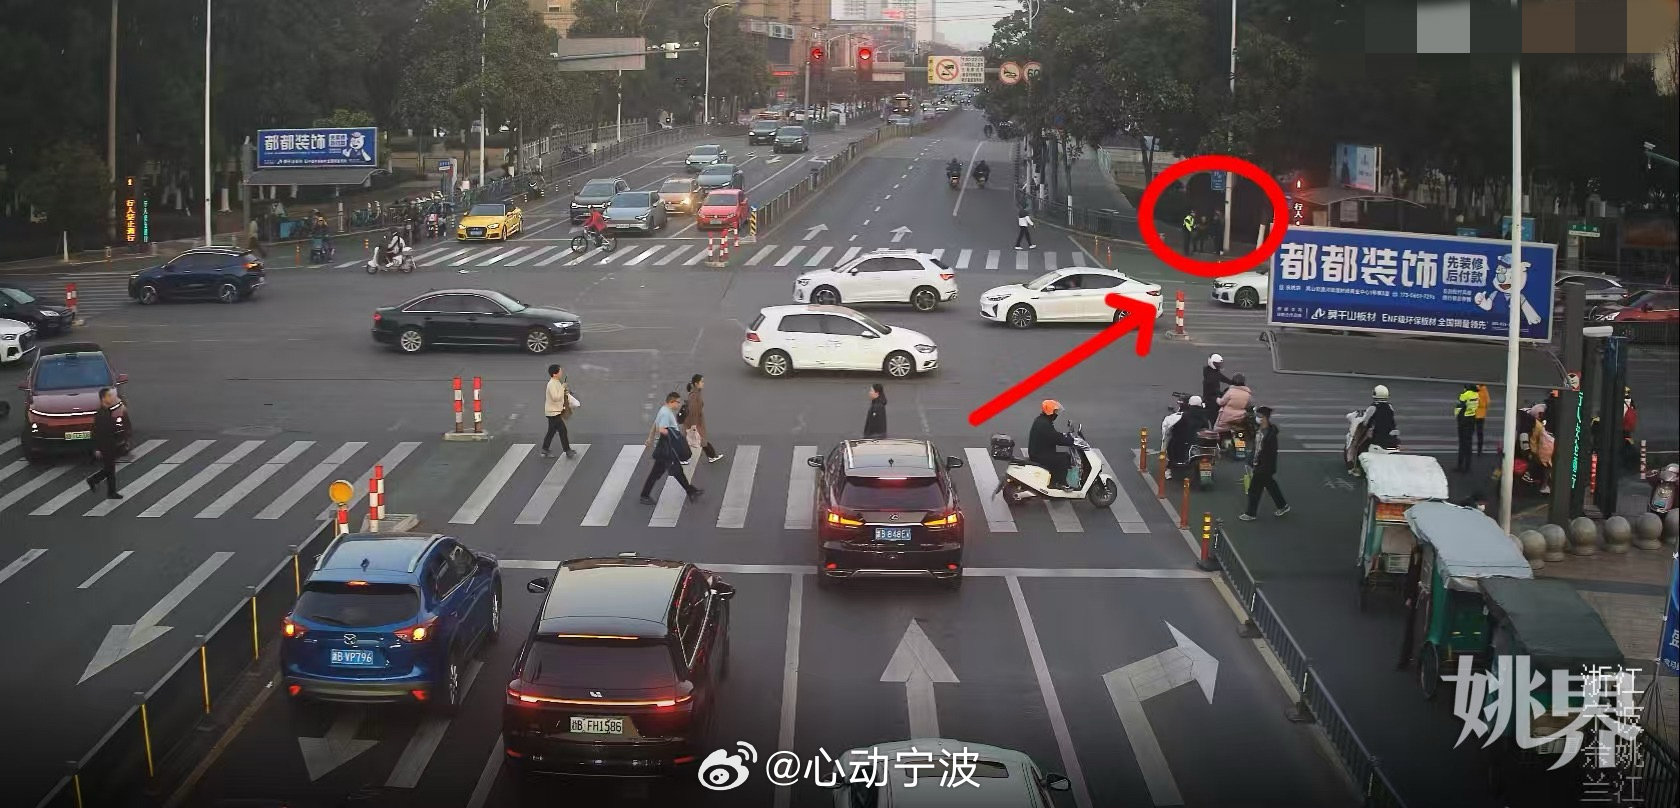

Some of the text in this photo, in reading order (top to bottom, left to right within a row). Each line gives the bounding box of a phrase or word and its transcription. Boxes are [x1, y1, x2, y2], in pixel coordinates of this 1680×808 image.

[265, 134, 326, 151] 都都装饰
[1280, 243, 1438, 288] 都都装饰
[1447, 255, 1484, 271] 先装修
[1446, 269, 1483, 284] 后付款
